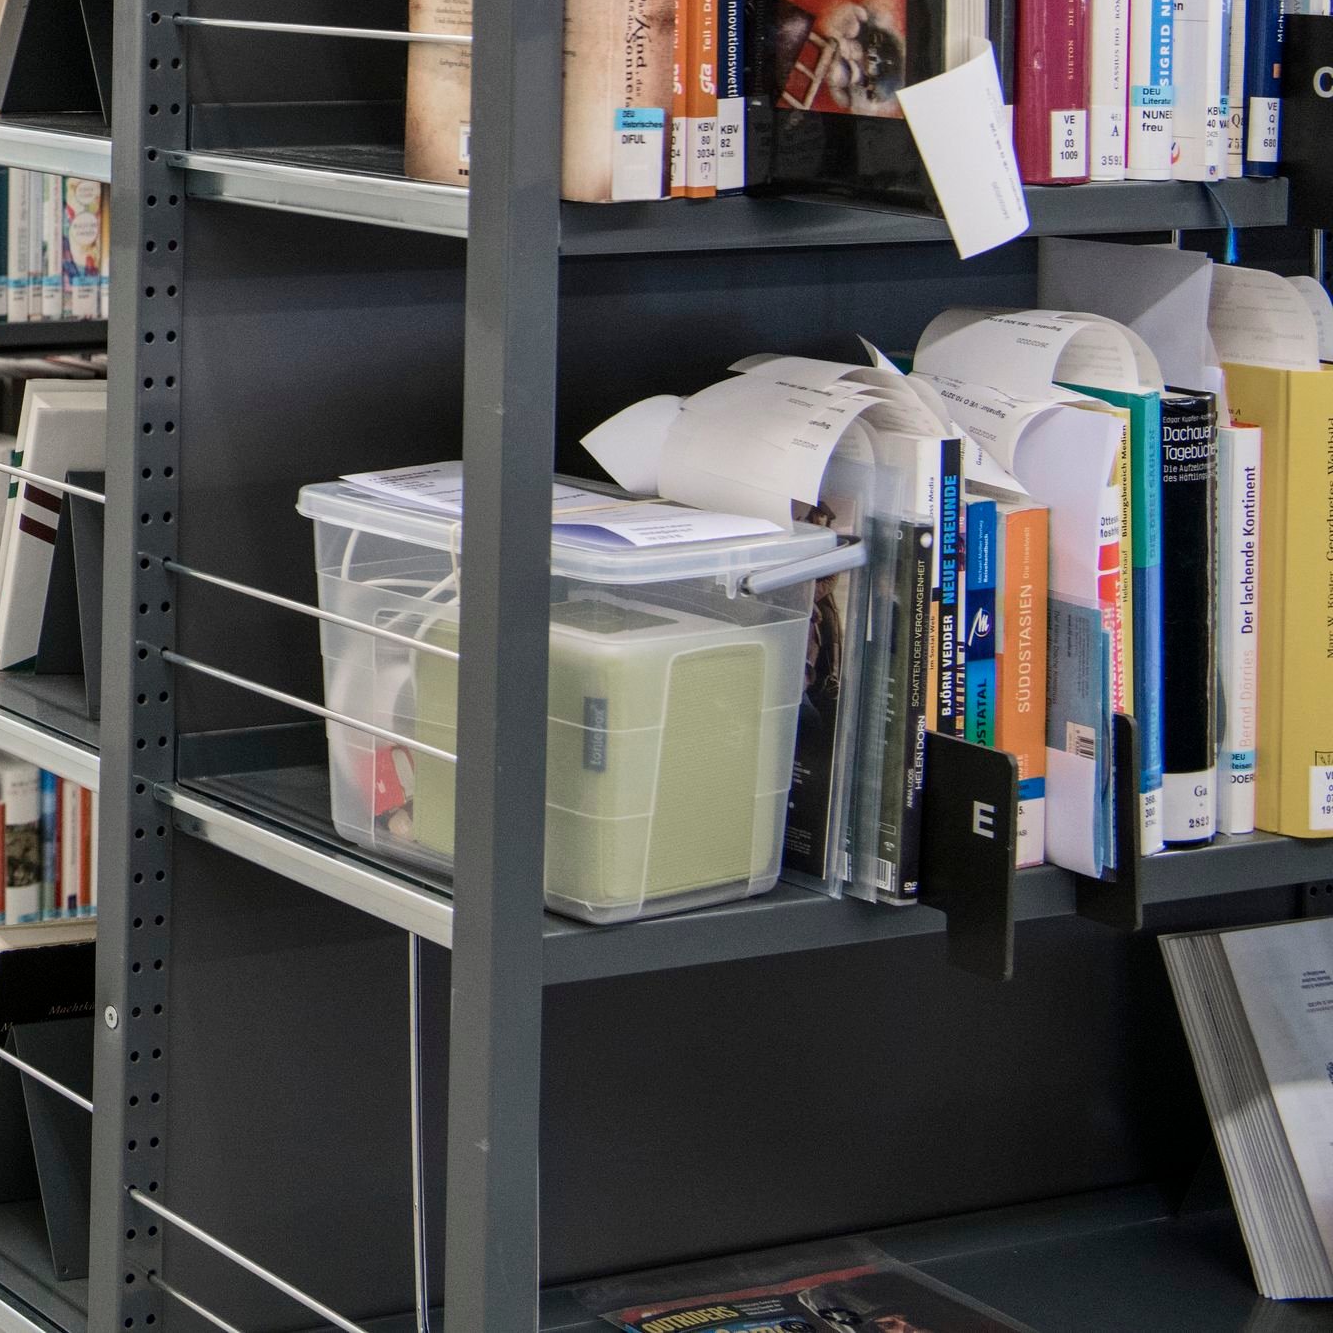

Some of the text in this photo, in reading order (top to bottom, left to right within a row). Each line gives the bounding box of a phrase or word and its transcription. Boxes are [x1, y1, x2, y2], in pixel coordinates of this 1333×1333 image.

[702, 30, 712, 51] Teil
[1159, 23, 1171, 87] SIGRID
[701, 63, 717, 96] gta
[1313, 66, 1333, 98] C
[1267, 102, 1278, 111] VE
[1064, 115, 1075, 124] VE
[1269, 115, 1275, 123] Q
[697, 122, 715, 132] KBV
[720, 124, 739, 134] KBV
[1111, 126, 1119, 136] A
[1142, 123, 1163, 132] freu
[1267, 127, 1276, 136] 11
[622, 134, 646, 144] DIFUL
[701, 136, 711, 145] 80
[720, 138, 731, 148] 82
[1064, 139, 1075, 148] 03
[1263, 138, 1277, 148] 680
[697, 149, 716, 159] 3034
[1060, 151, 1078, 160] 1009
[1162, 416, 1180, 424] Edgar
[1163, 425, 1213, 442] Dachauer
[1163, 465, 1177, 473] Die
[1163, 474, 1177, 482] des
[942, 474, 958, 716] BJÖRN VEDDER NEUE FREUNDE
[1239, 466, 1256, 748] Bernd Dörries Der lachende Kontinent
[1017, 584, 1033, 713] SÜDOSTASIEN
[911, 559, 927, 790] HELEN DORN SCHATTEN DER VERGANGENHEIT
[906, 787, 914, 808] ANNA
[973, 801, 995, 839] E
[641, 1304, 740, 1333] OUTRIDERS
